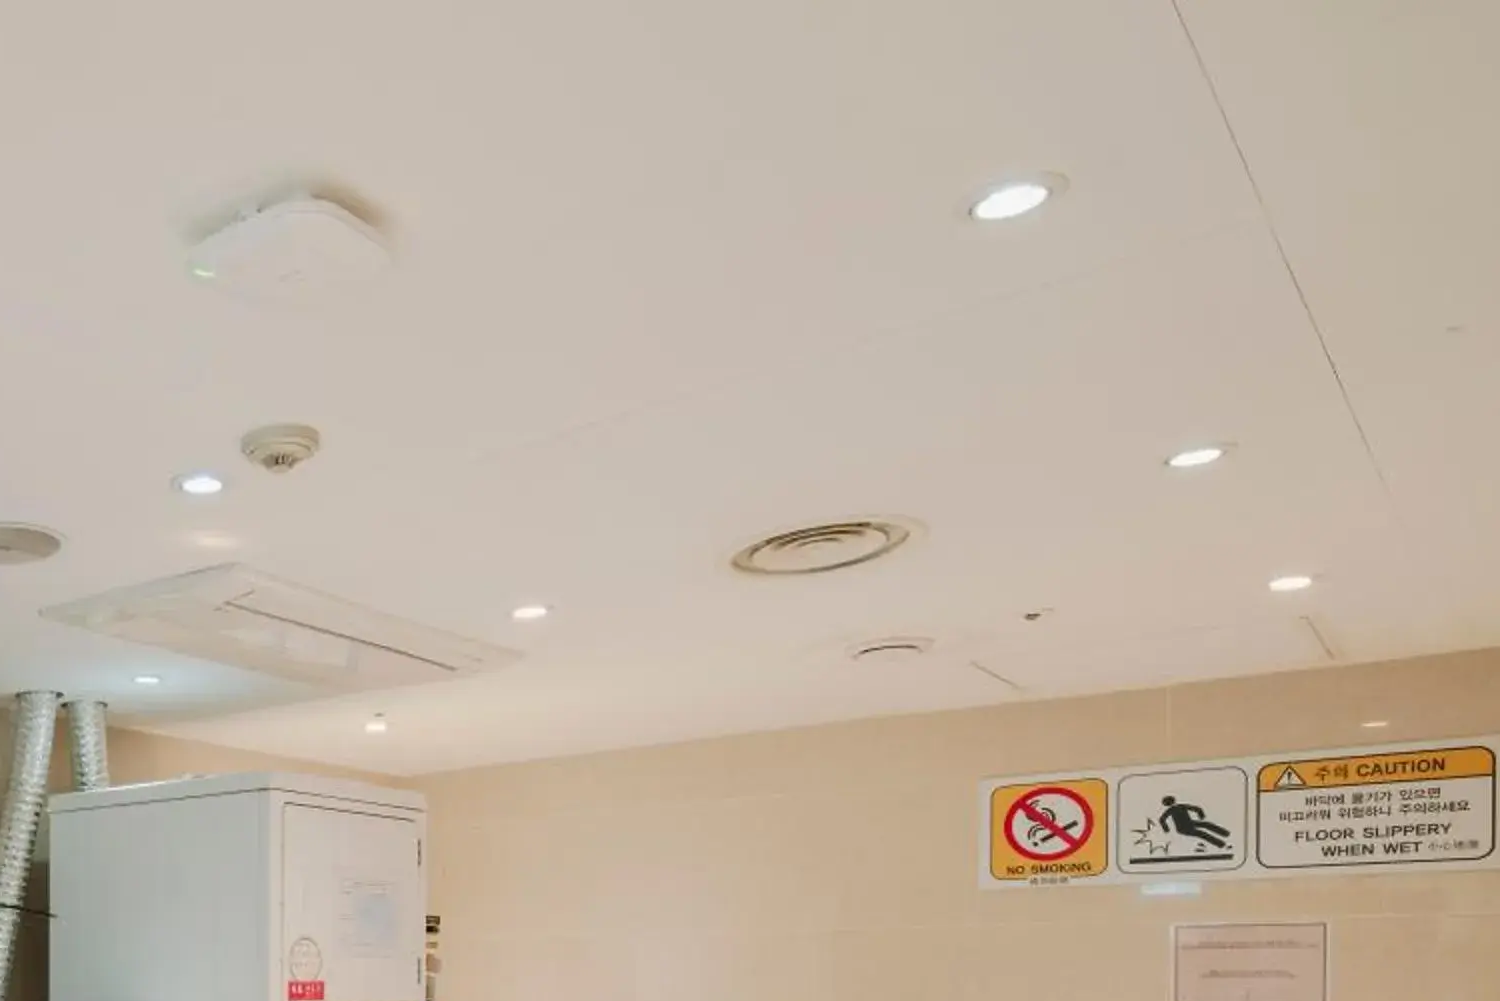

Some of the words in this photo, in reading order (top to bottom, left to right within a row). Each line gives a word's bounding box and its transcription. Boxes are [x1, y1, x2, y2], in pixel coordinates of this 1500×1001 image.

[1315, 765, 1349, 782] 주의
[1357, 758, 1446, 777] CAUTION
[1294, 828, 1354, 842] FLOOR
[1363, 823, 1452, 839] SLIPPERY
[1321, 842, 1375, 857] WHEN
[1383, 841, 1423, 854] WET
[1006, 864, 1025, 875] NO
[1031, 862, 1093, 874] SMOKING
